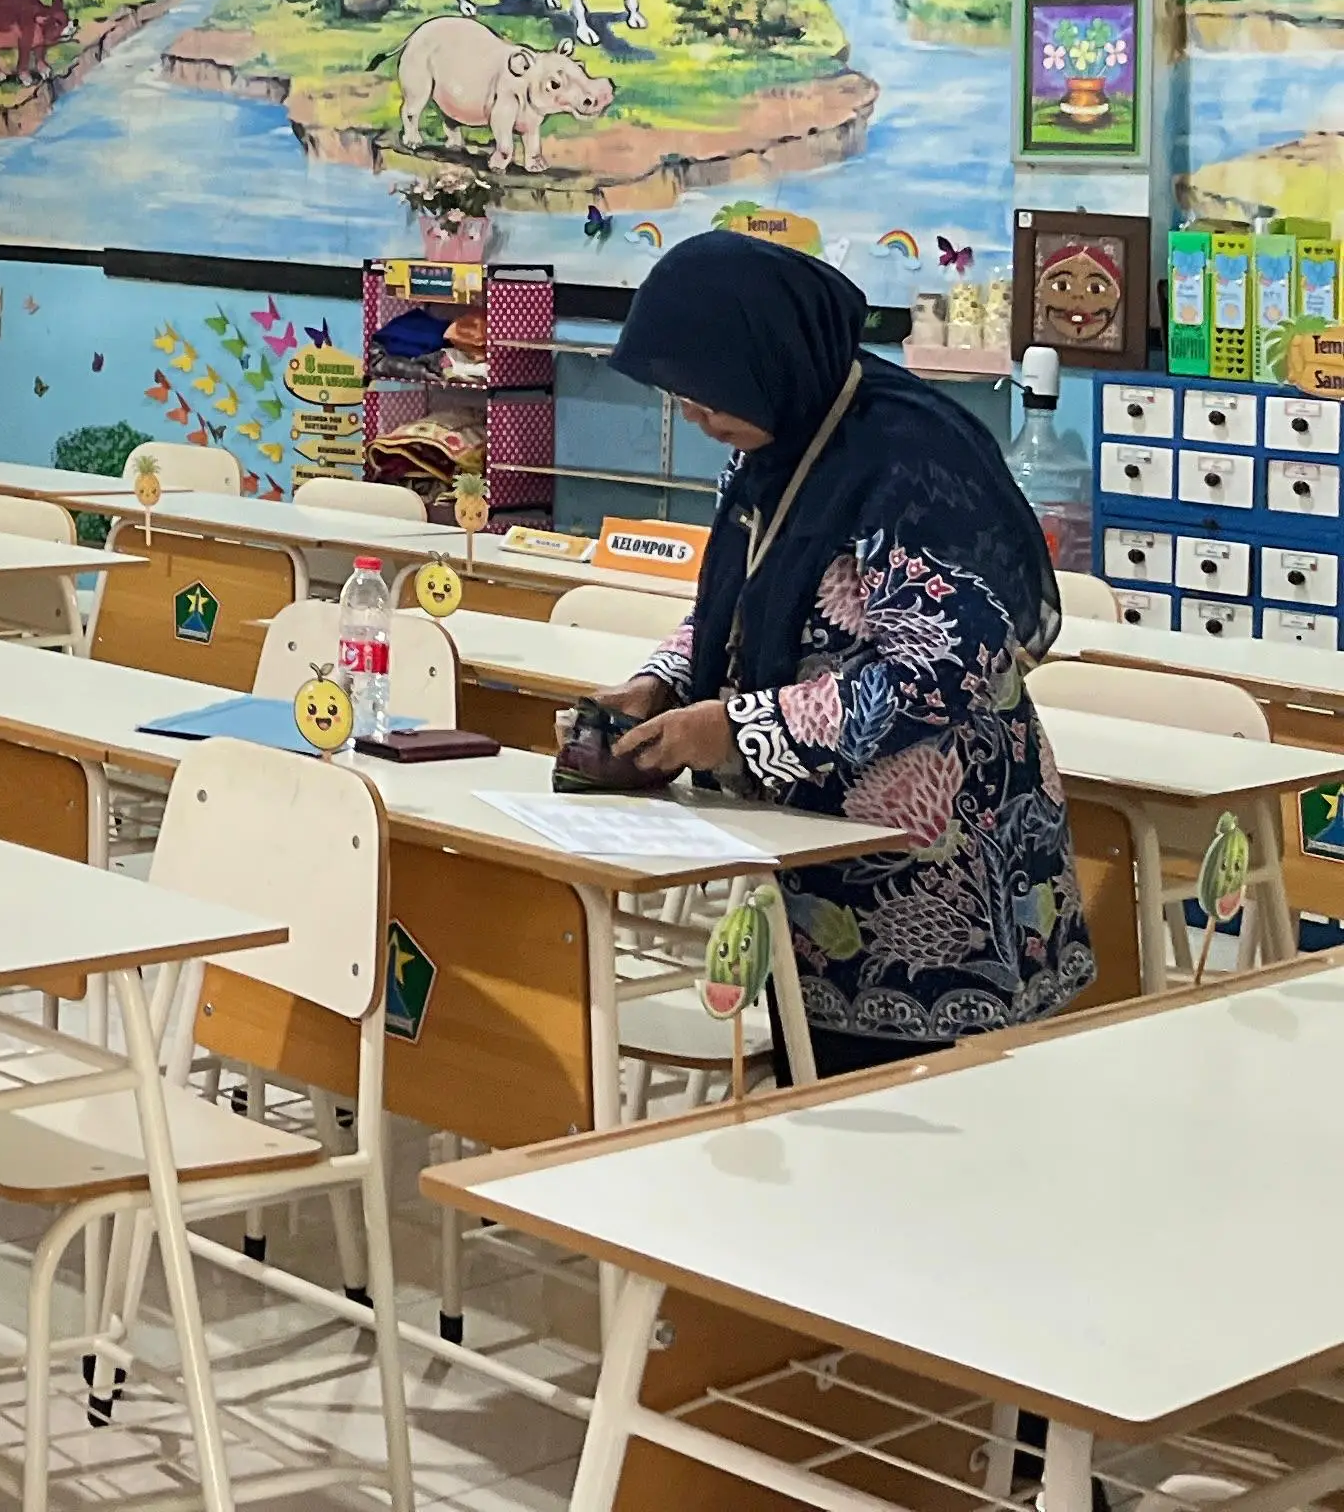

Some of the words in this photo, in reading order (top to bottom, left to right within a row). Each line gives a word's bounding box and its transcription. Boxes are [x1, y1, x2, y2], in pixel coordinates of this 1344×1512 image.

[746, 215, 788, 236] Tempat
[1312, 335, 1344, 356] Tem
[1314, 370, 1344, 389] San
[611, 535, 676, 558] KELOMPOK
[677, 546, 687, 559] 5
